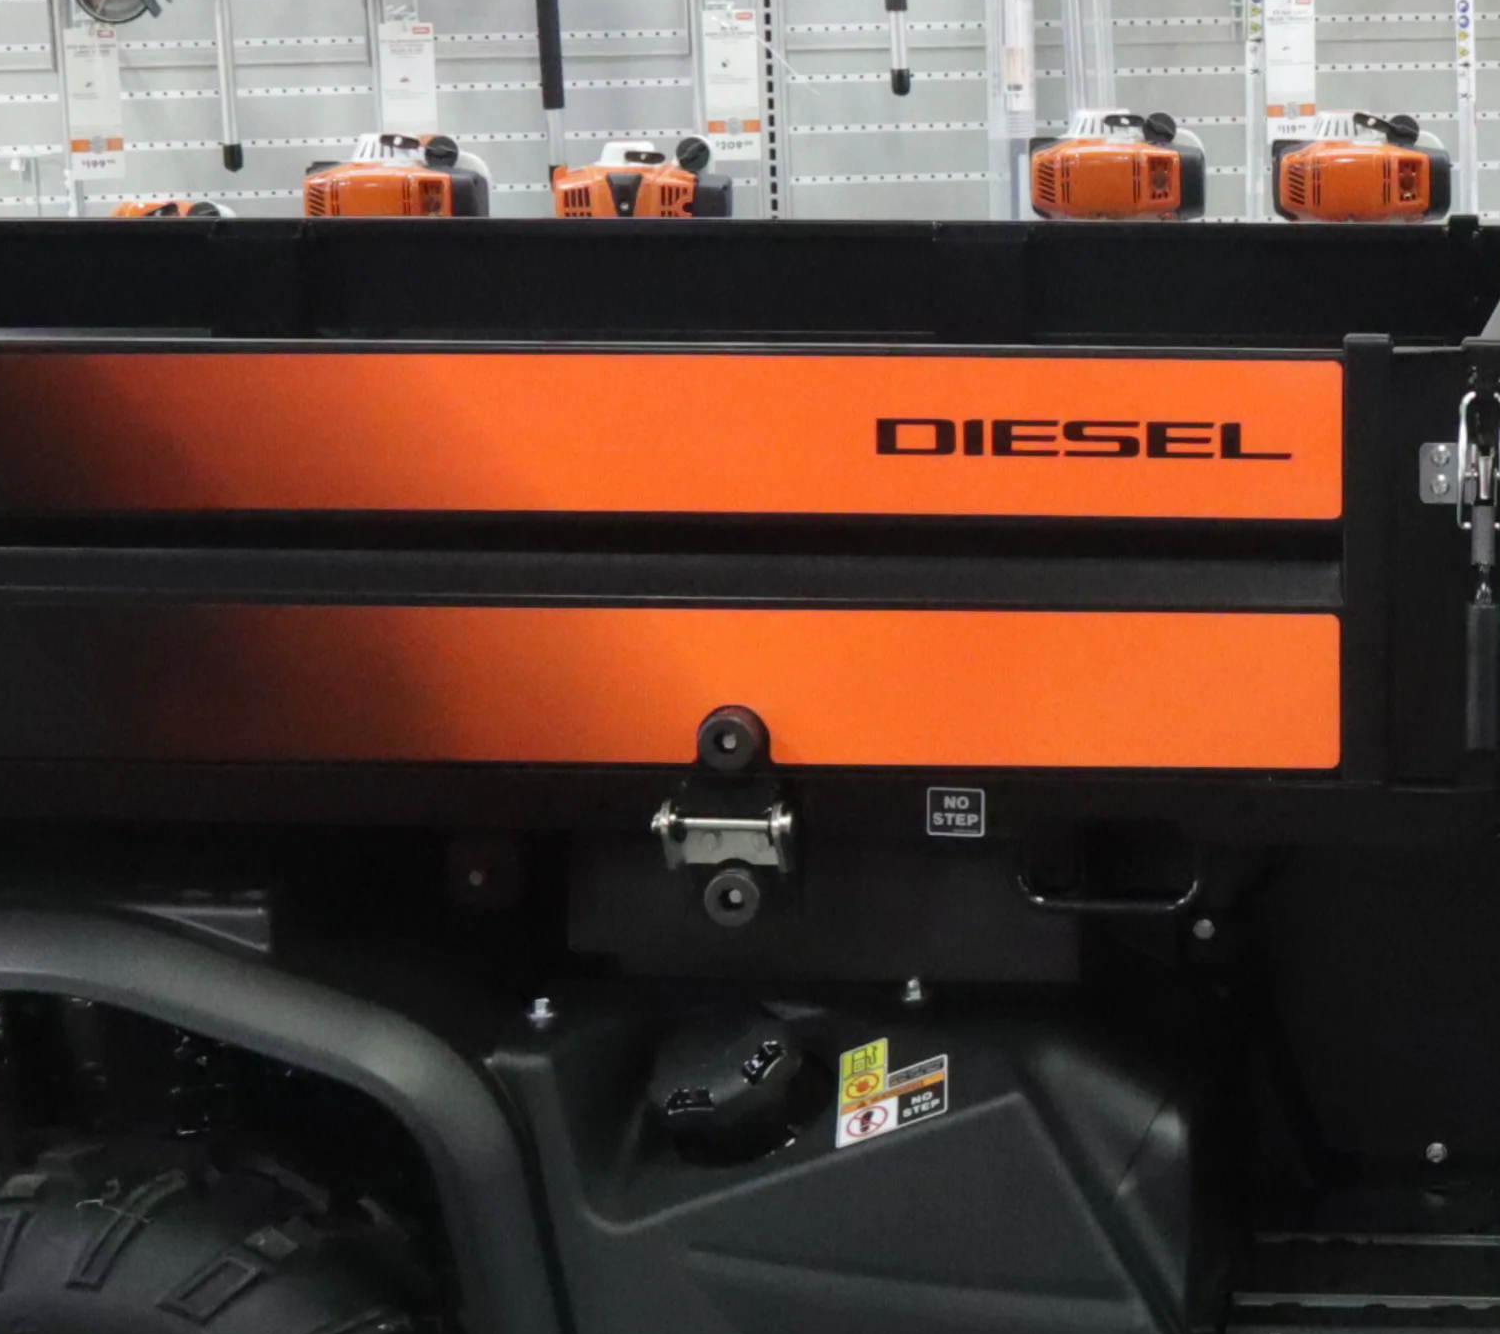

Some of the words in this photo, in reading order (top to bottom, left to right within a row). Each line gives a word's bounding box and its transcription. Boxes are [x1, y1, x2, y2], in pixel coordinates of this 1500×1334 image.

[875, 418, 1292, 460] DIESEL
[943, 795, 970, 810] NO
[932, 812, 979, 827] STEP
[911, 1091, 933, 1105] NO
[902, 1098, 940, 1119] STEP
